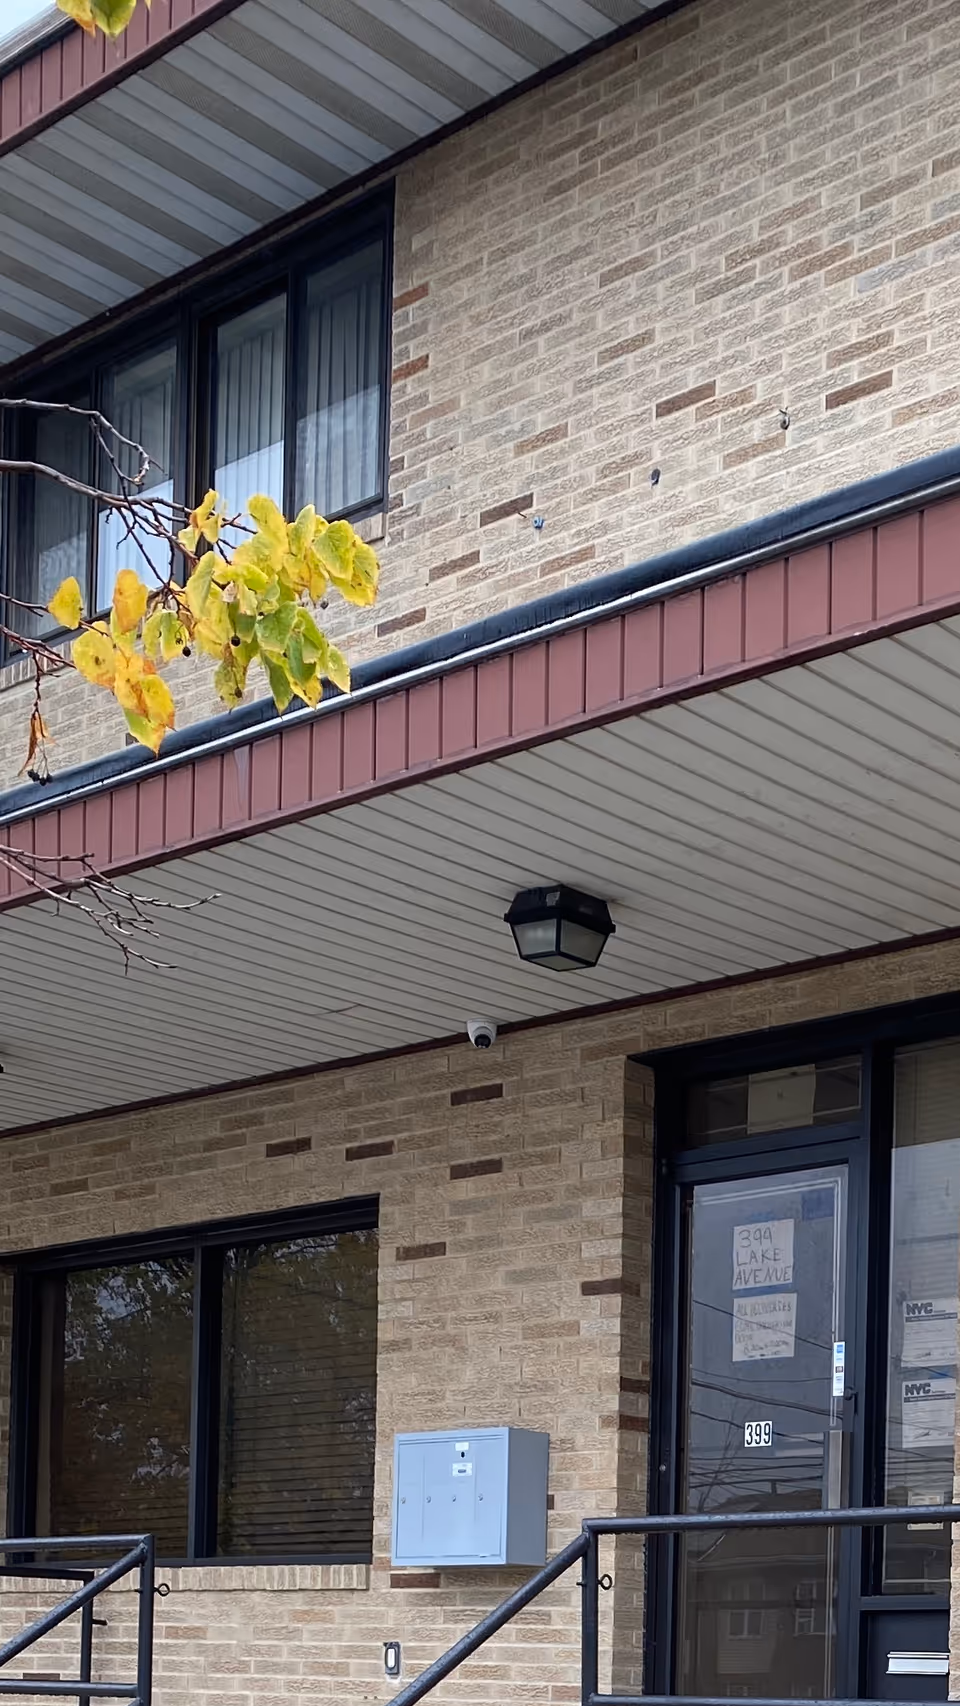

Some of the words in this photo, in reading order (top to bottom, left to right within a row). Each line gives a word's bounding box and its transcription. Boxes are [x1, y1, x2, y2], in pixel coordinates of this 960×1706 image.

[738, 1227, 773, 1248] 399
[736, 1248, 782, 1266] LAKE
[734, 1265, 792, 1287] AVENUE
[906, 1302, 933, 1315] NYC
[905, 1383, 931, 1396] NYC
[746, 1423, 771, 1445] 399
